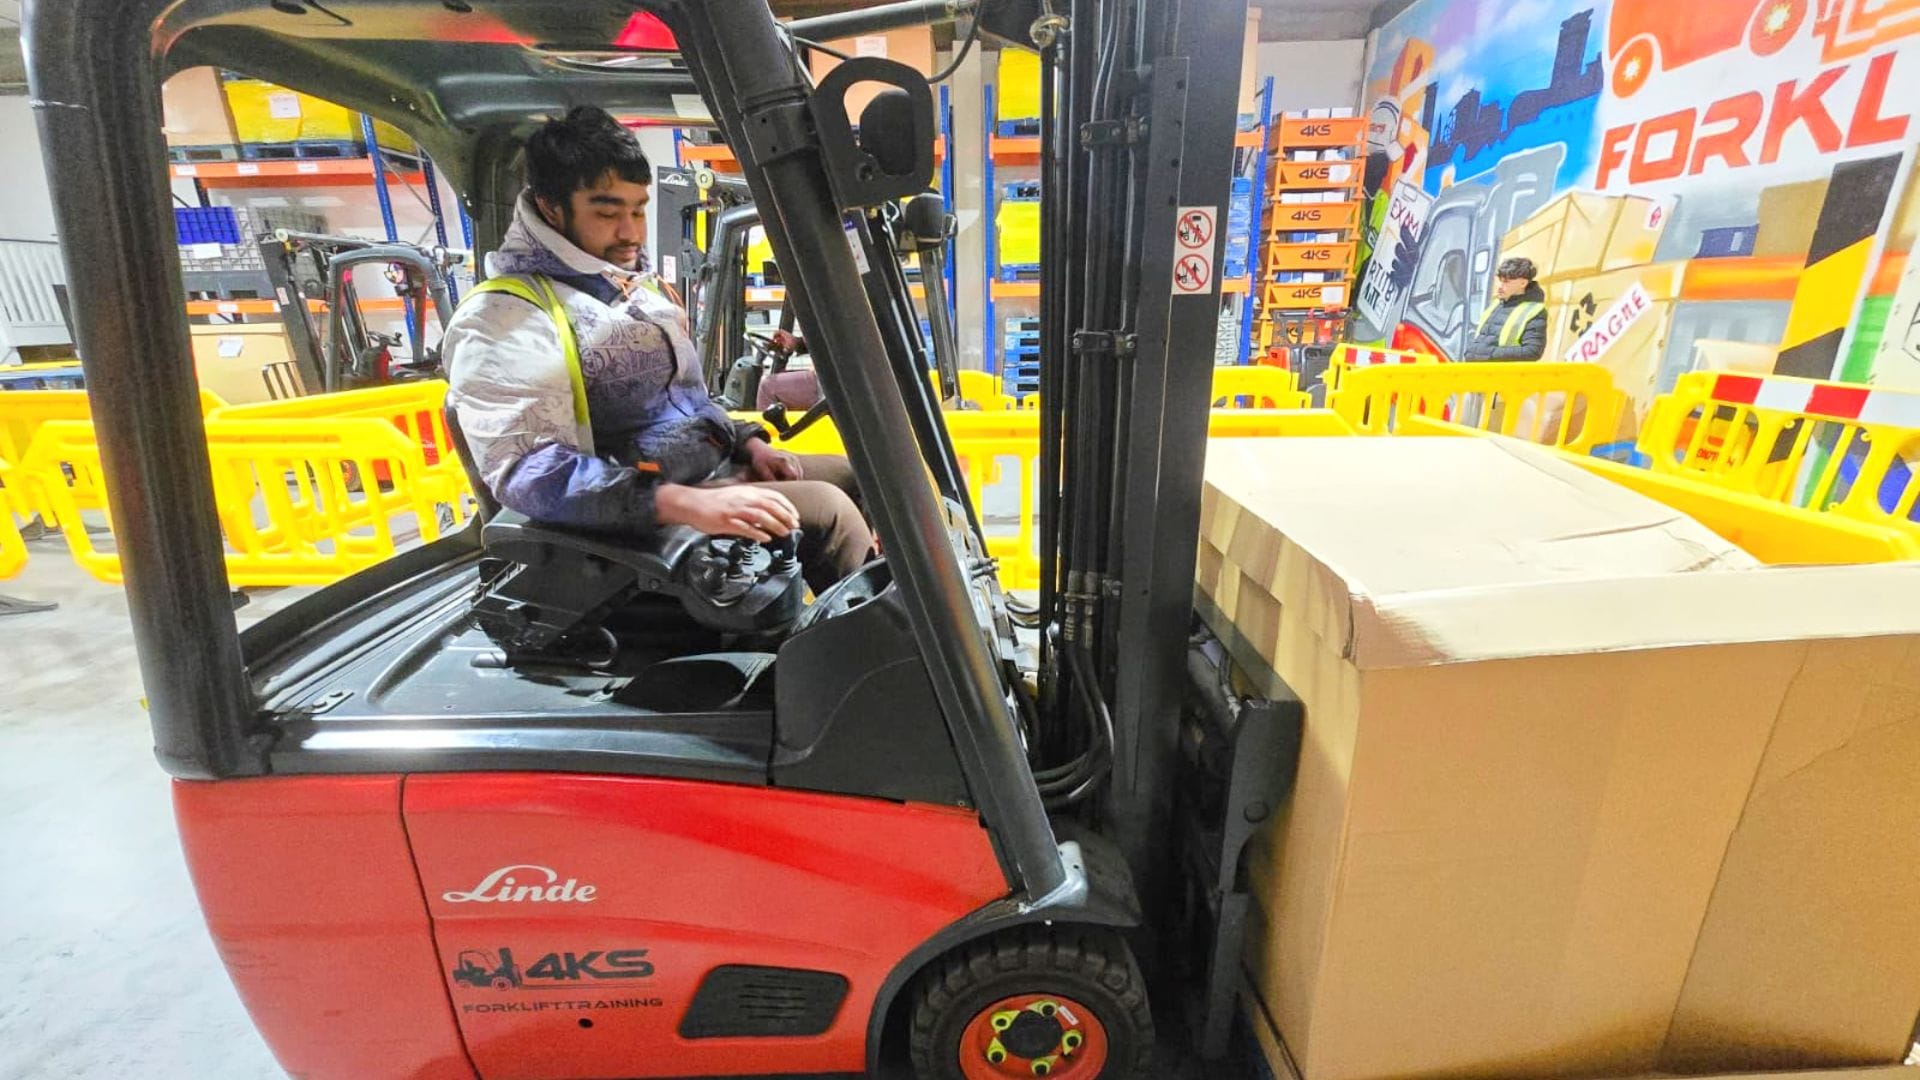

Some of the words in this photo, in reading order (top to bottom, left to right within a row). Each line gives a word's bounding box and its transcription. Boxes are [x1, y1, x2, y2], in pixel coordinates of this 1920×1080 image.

[1595, 50, 1910, 190] FORKL
[1300, 124, 1331, 137] 4KS
[1299, 168, 1330, 179] 4KS
[1291, 210, 1321, 221] 4KS
[1301, 249, 1331, 260] 4KS
[1292, 287, 1321, 299] 4KS
[443, 864, 597, 903] Linde
[525, 950, 655, 981] 4KS
